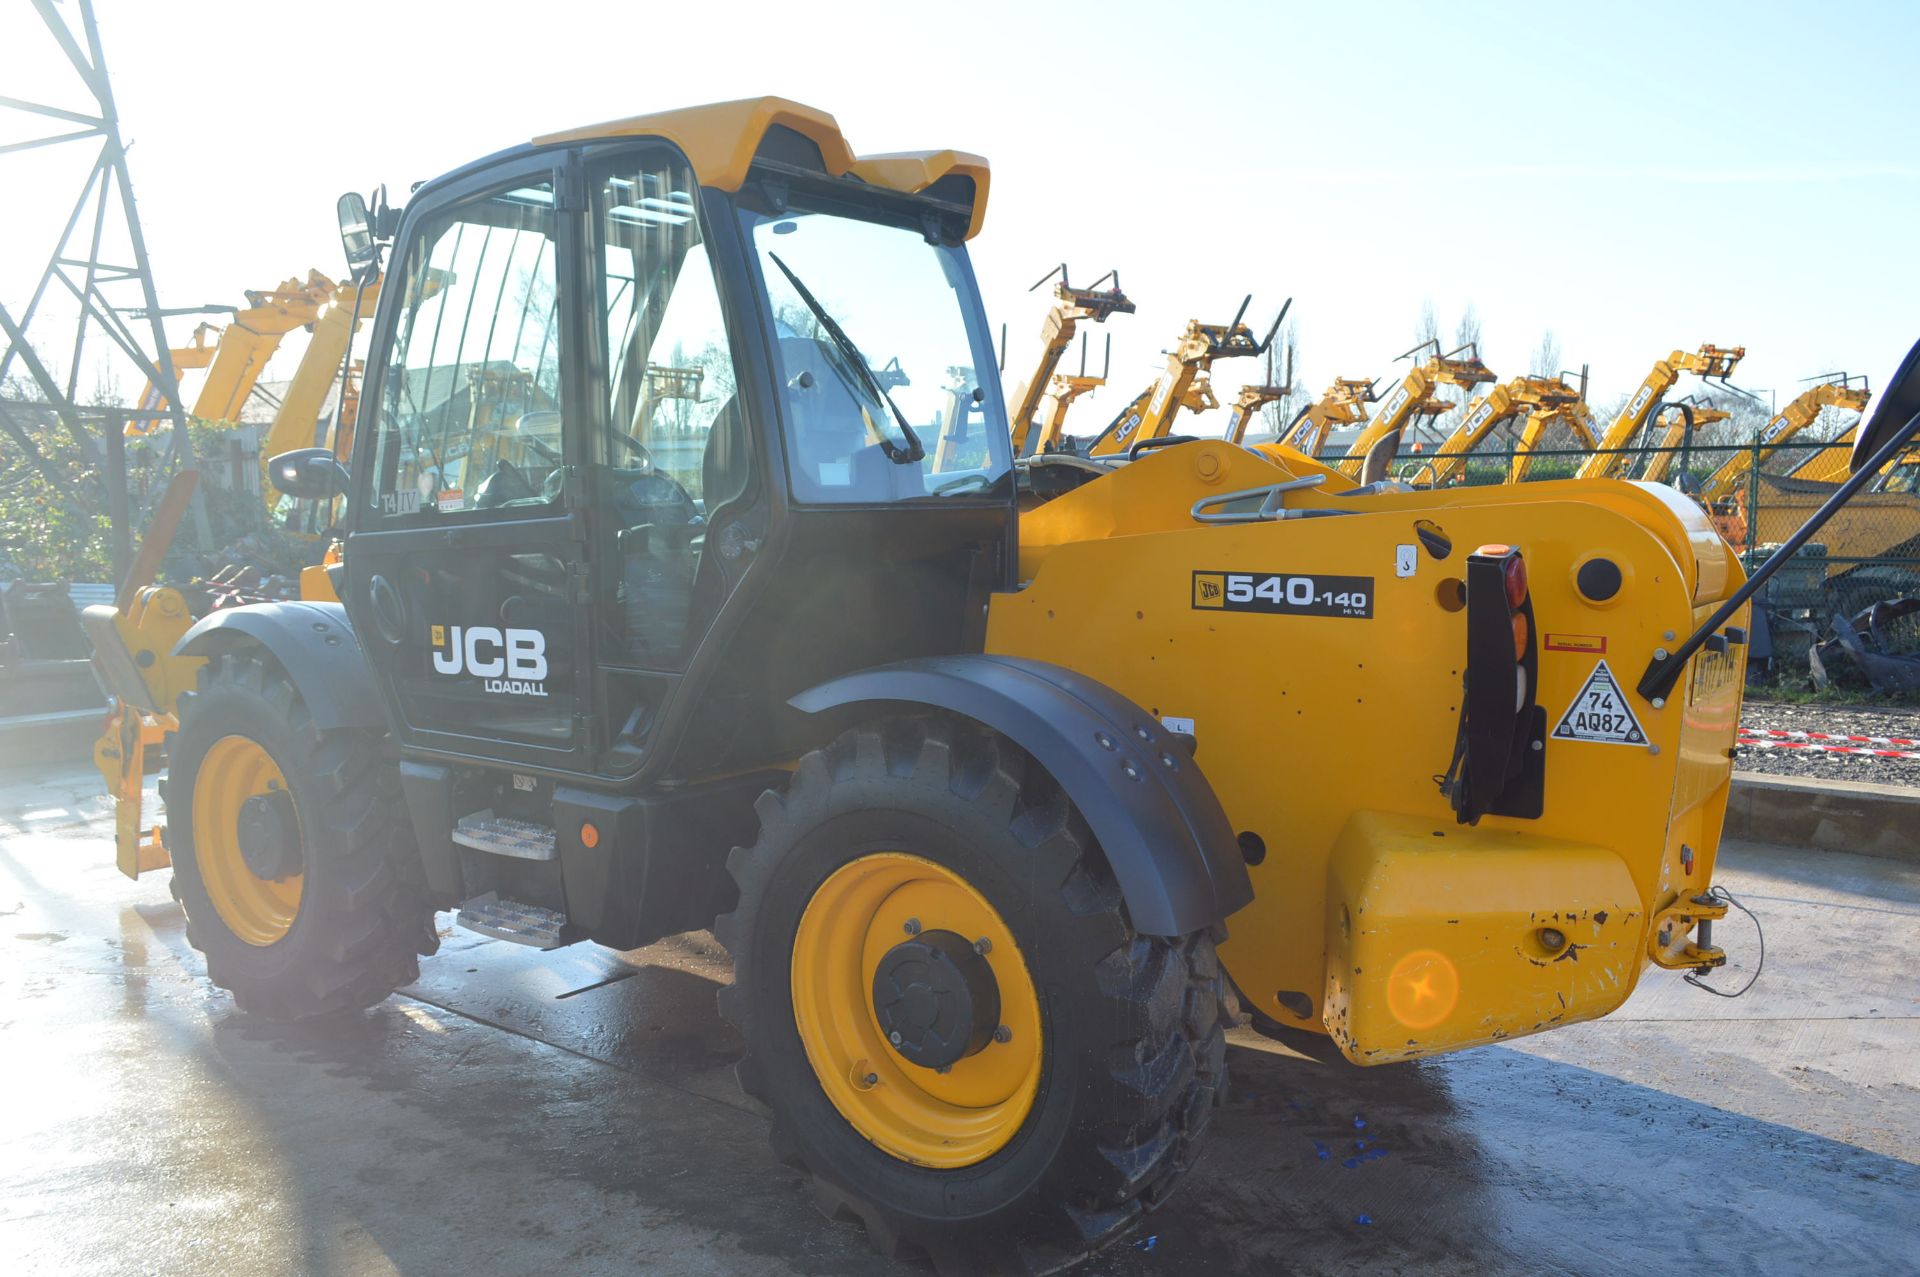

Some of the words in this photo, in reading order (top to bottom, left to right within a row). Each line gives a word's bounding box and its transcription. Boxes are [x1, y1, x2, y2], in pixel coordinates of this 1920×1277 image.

[1383, 388, 1409, 425] JCB
[1629, 385, 1653, 420] JCB
[1117, 414, 1141, 442] JCB
[1293, 420, 1313, 446] JCB
[1465, 403, 1493, 437] JCB
[1761, 417, 1789, 445] JCB
[382, 493, 397, 513] T4
[1202, 582, 1219, 599] JCB
[1227, 575, 1366, 608] 540-140
[432, 626, 548, 681] JCB
[484, 680, 548, 696] LOADALL
[1589, 692, 1613, 711] 74
[1576, 712, 1625, 734] AQ8Z
